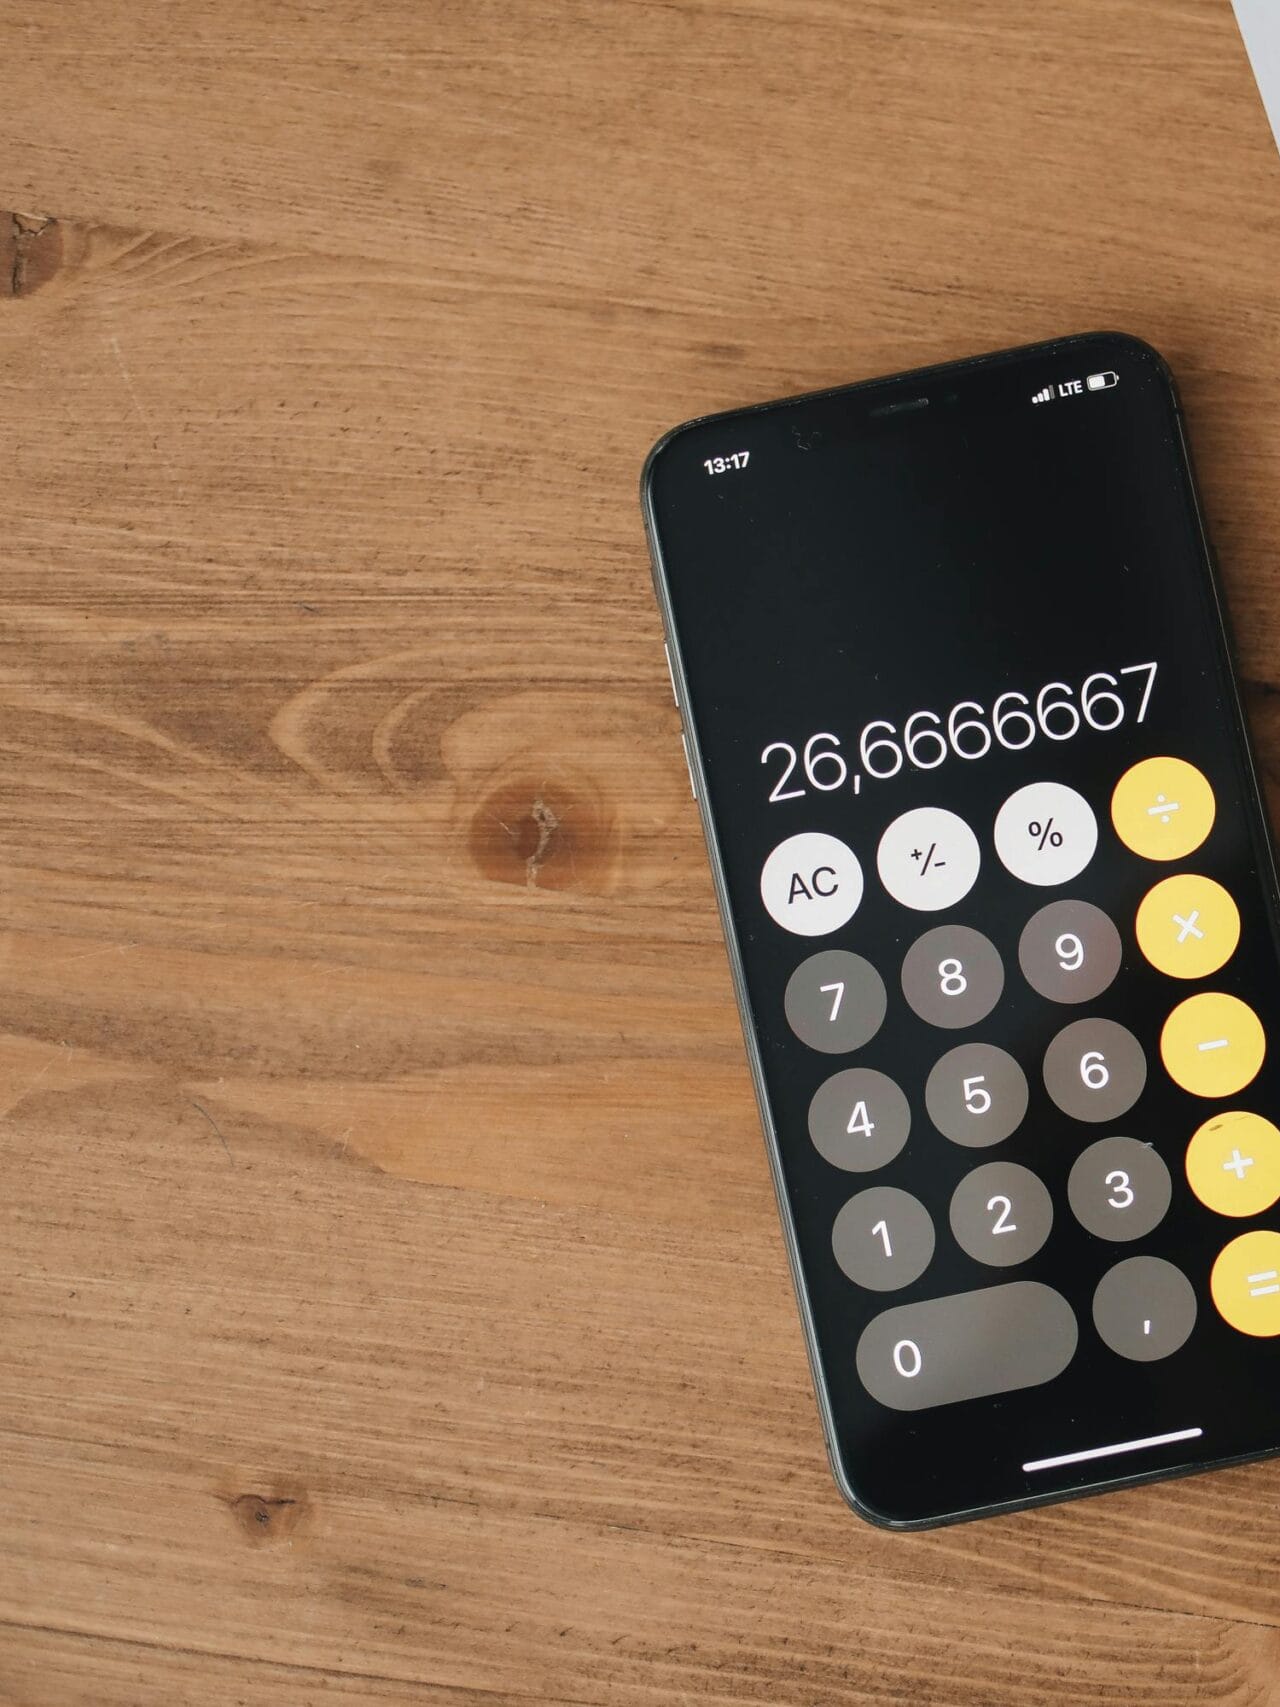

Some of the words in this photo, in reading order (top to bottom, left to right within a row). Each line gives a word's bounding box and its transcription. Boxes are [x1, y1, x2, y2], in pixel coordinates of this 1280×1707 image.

[1058, 380, 1084, 397] LTE
[703, 451, 750, 475] 13:17
[760, 661, 1158, 803] 26,6666667
[788, 866, 839, 905] AC
[1028, 817, 1064, 851] %
[819, 982, 845, 1022] 7
[938, 958, 968, 996] 8
[1054, 933, 1084, 971] 9
[846, 1100, 875, 1137] 4
[963, 1075, 992, 1115] 5
[1079, 1051, 1109, 1090] 6
[871, 1220, 893, 1257] 1
[986, 1195, 1017, 1235] 2
[1105, 1170, 1134, 1209] 3
[893, 1339, 922, 1378] 0
